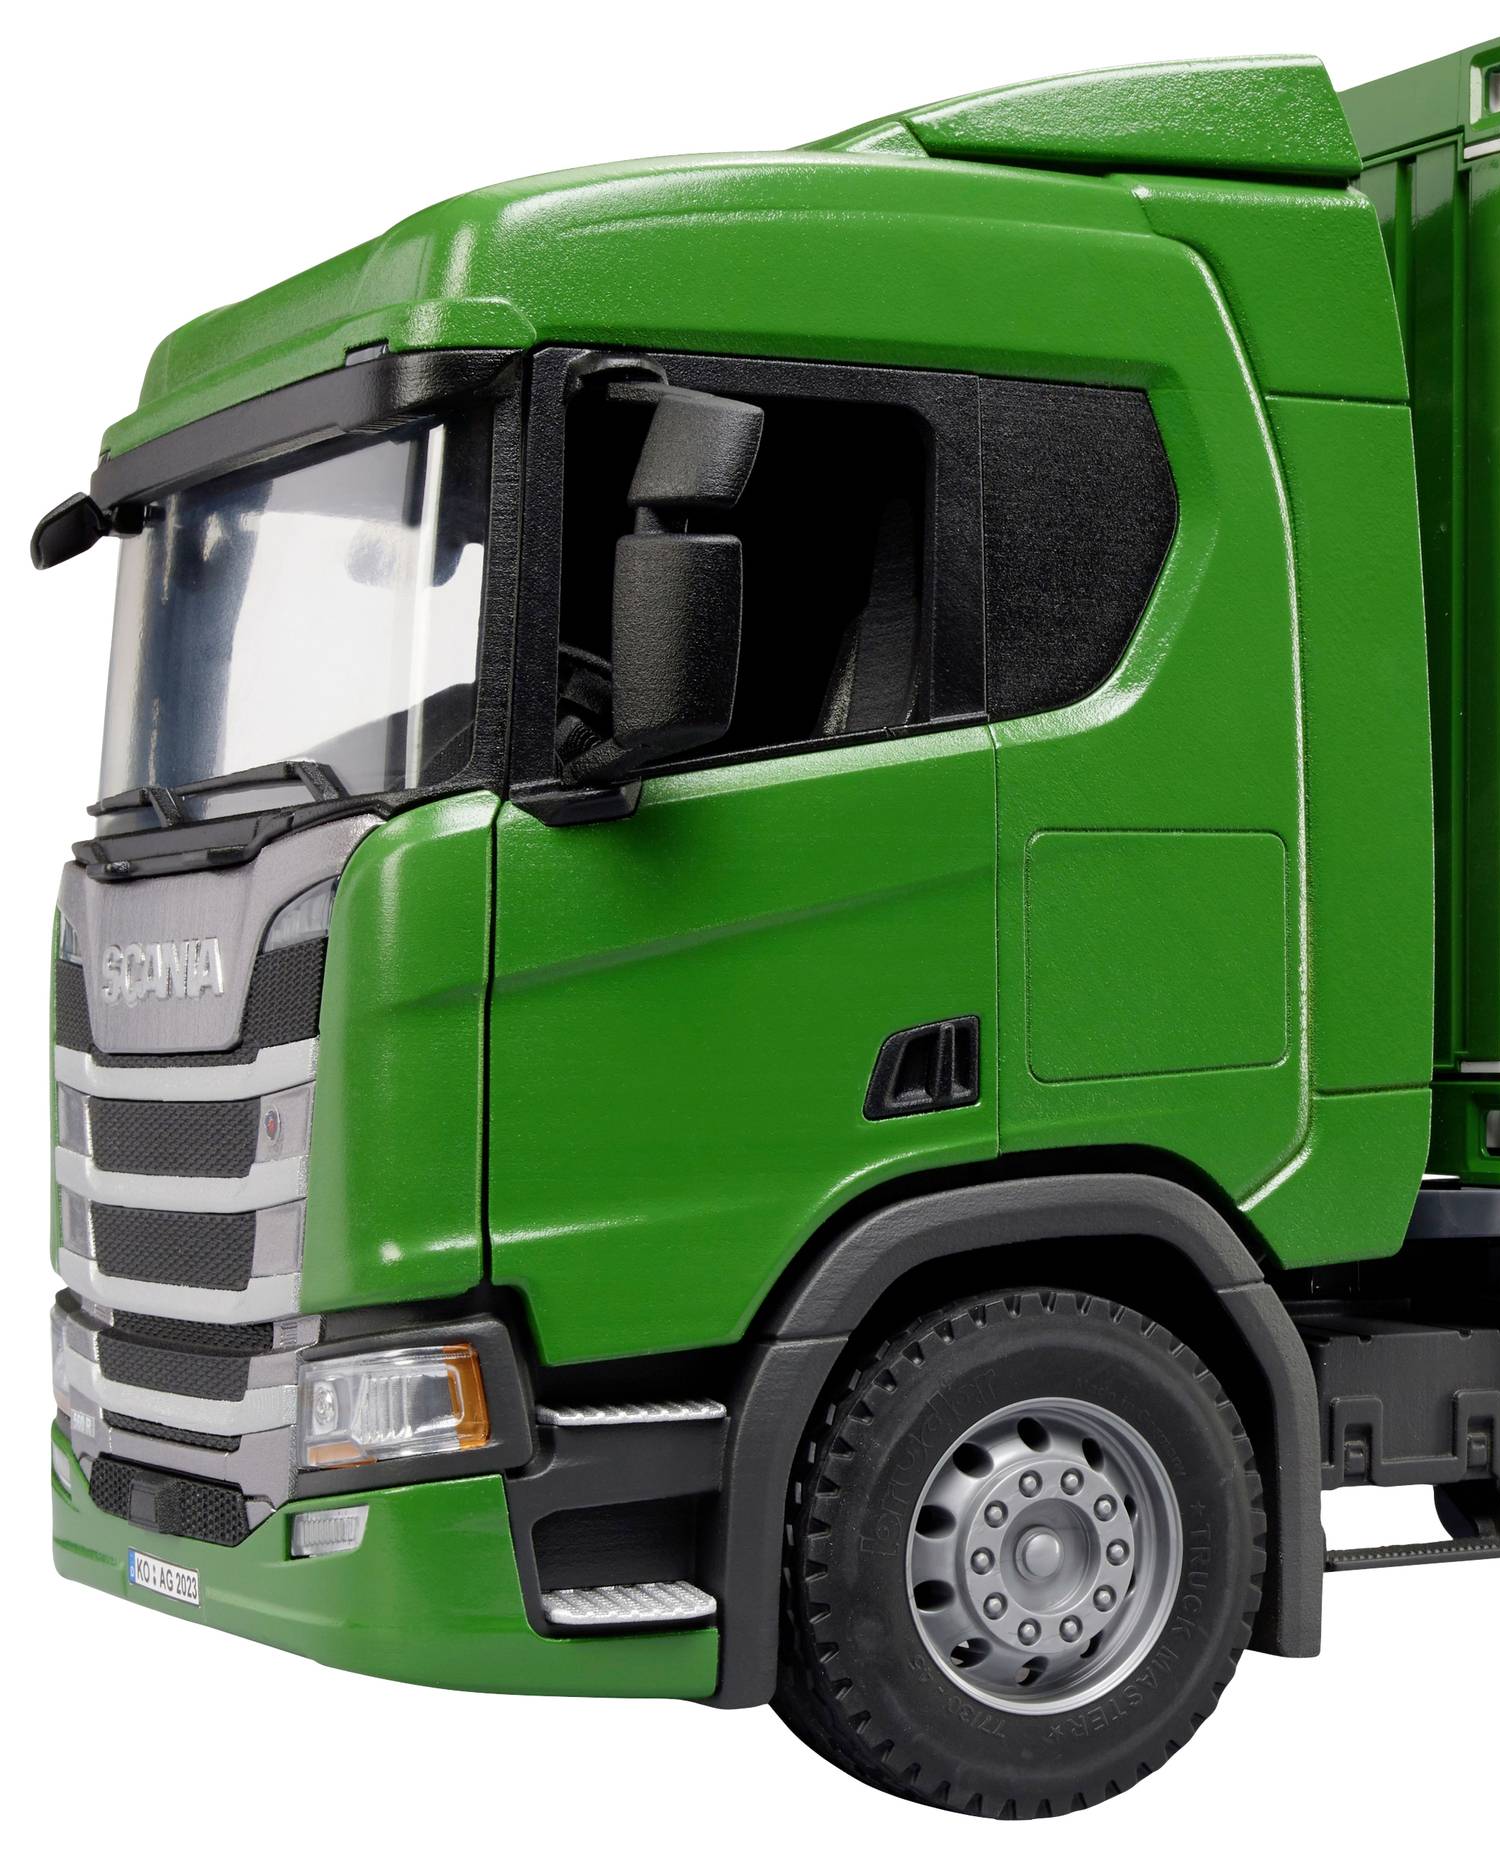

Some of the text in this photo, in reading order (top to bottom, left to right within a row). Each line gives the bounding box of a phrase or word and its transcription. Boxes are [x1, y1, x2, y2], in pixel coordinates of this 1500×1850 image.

[102, 937, 223, 1006] SCANIA
[137, 1557, 150, 1583] KO
[160, 1567, 174, 1592] AG
[175, 1572, 198, 1600] 2023
[1065, 1523, 1212, 1737] TRUCK MASTER
